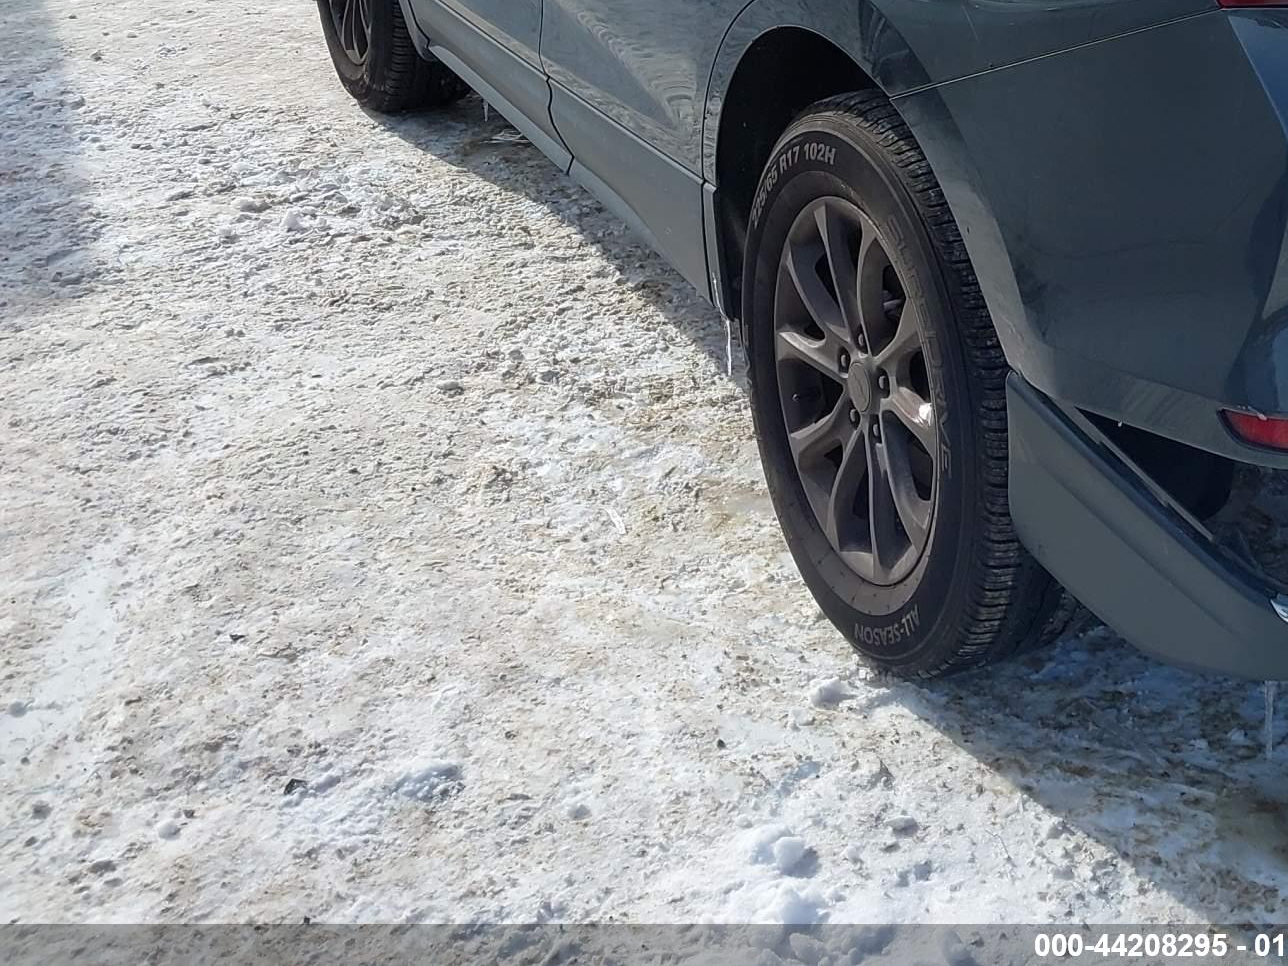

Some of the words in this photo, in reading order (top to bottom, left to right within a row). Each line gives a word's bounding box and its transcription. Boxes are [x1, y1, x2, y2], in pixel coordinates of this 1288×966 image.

[779, 146, 800, 174] R17
[803, 143, 836, 165] 102H
[854, 604, 921, 645] ALL-SEASON
